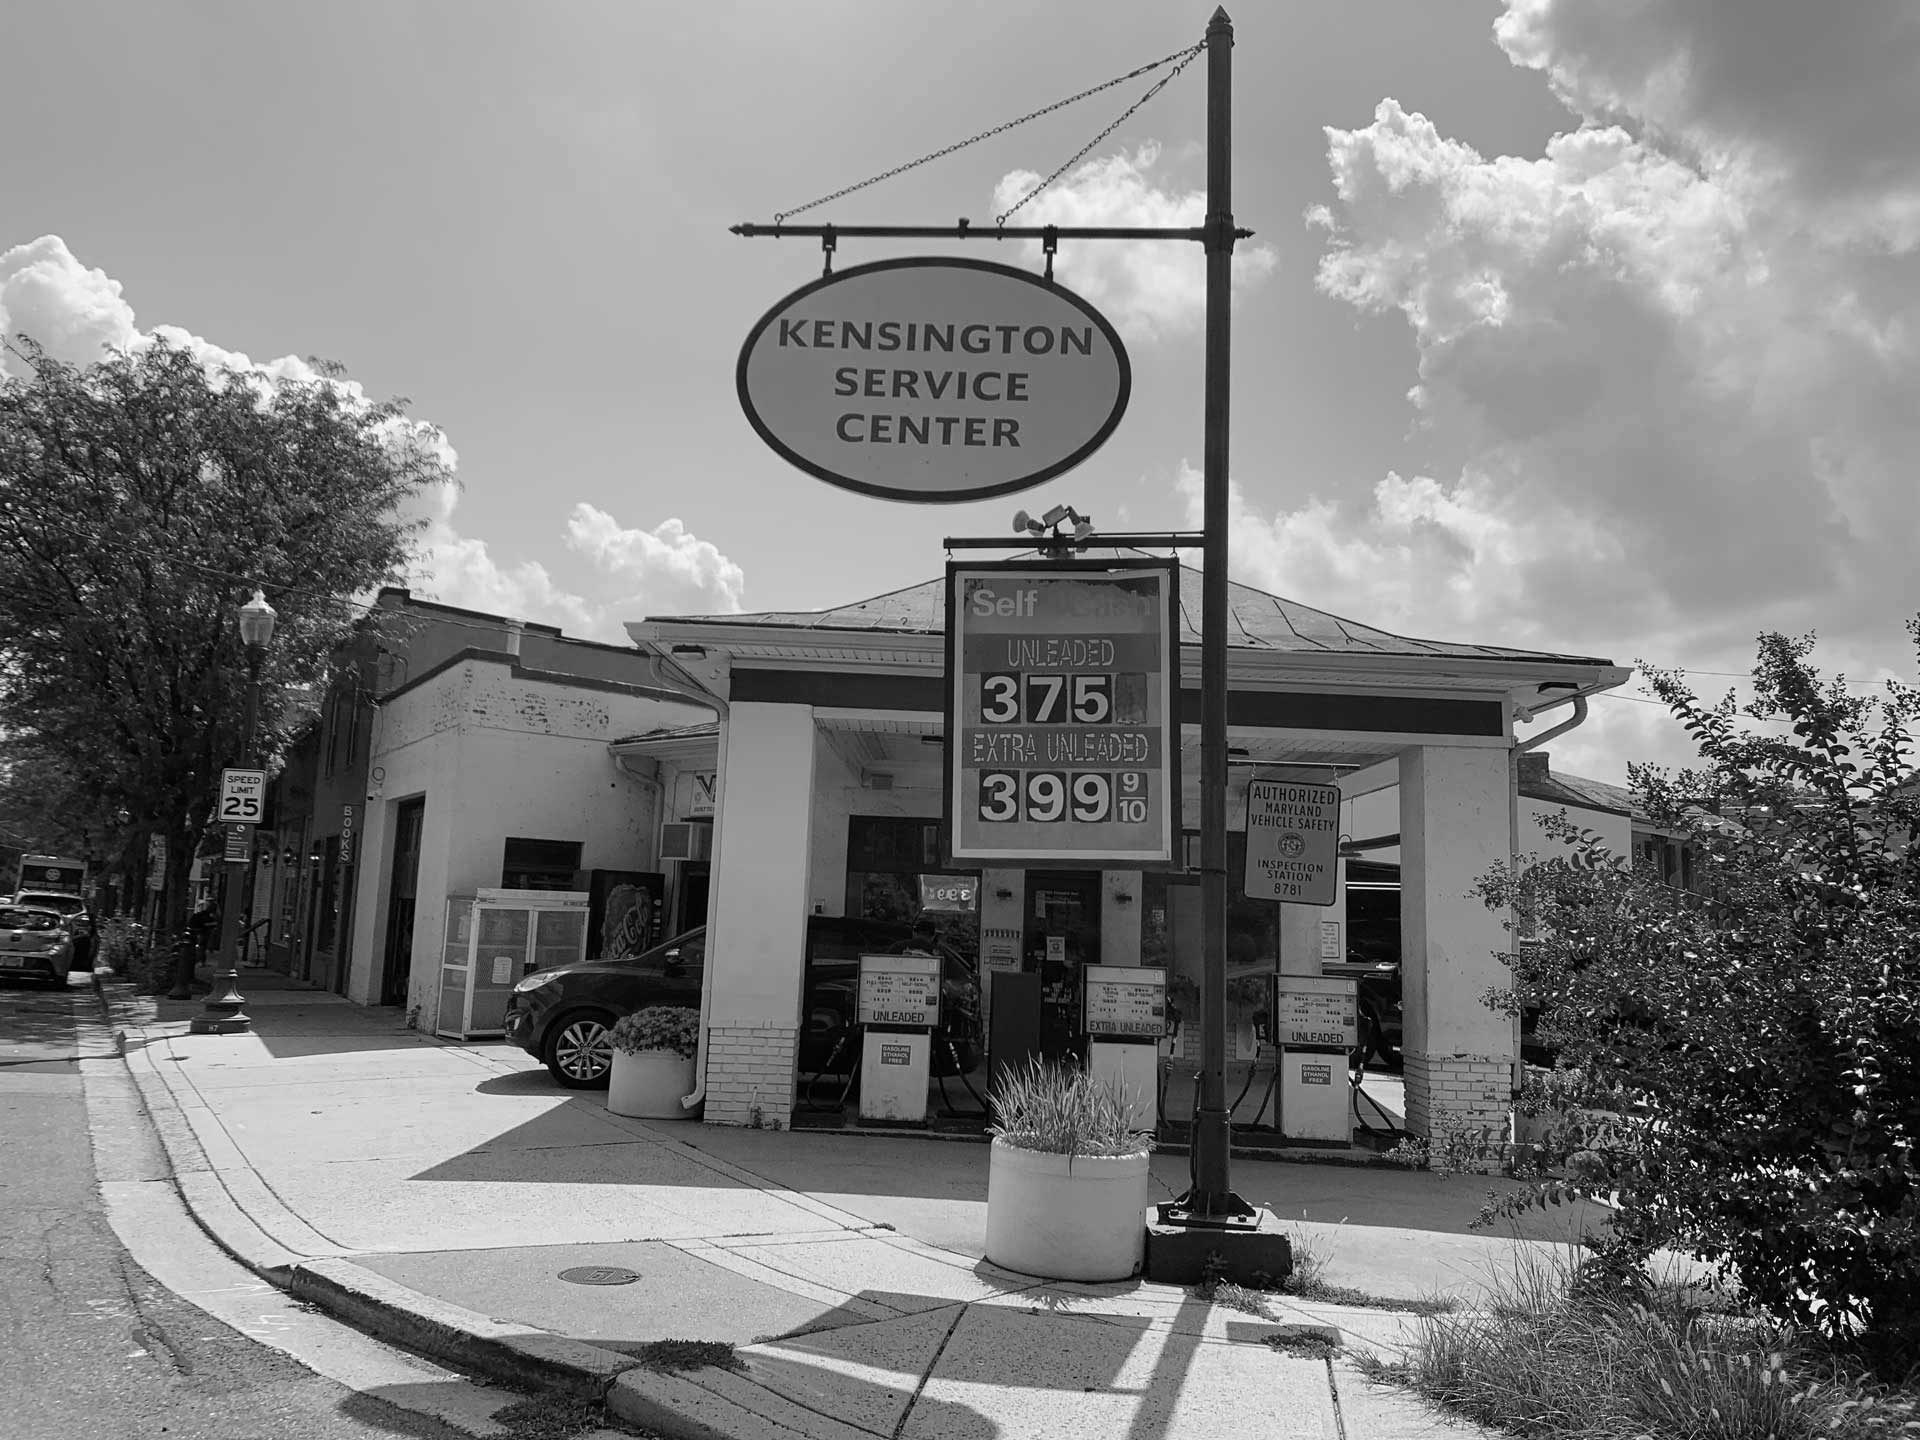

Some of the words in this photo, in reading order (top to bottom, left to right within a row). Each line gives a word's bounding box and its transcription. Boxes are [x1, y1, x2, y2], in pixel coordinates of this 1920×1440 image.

[777, 319, 1093, 355] KENSINGTON
[834, 367, 1029, 401] SERVICE
[836, 413, 1022, 447] CENTER
[972, 589, 1038, 617] Self
[1008, 639, 1115, 667] UNLEADED
[982, 675, 1109, 723] 375
[973, 733, 1037, 762] EXTRA
[1047, 733, 1148, 762] UNLEADED
[227, 775, 261, 784] SPEED
[230, 786, 255, 794] LIMIT
[980, 773, 1110, 822] 399
[1253, 786, 1335, 805] AUTHORIZED
[223, 796, 259, 817] 25
[1265, 802, 1322, 817] MARYLAND
[1251, 814, 1293, 829] VEHICLE
[1298, 818, 1335, 831] SAFETY
[340, 805, 353, 862] BOOKS
[1257, 859, 1324, 873] INSPECTION
[1267, 869, 1312, 882] STATION
[1273, 882, 1302, 896] 8781
[872, 1010, 925, 1023] UNLEADED
[1089, 1020, 1117, 1032] EXTRA
[1120, 1022, 1163, 1034] UNLEADED
[1291, 1031, 1344, 1044] UNLEADED
